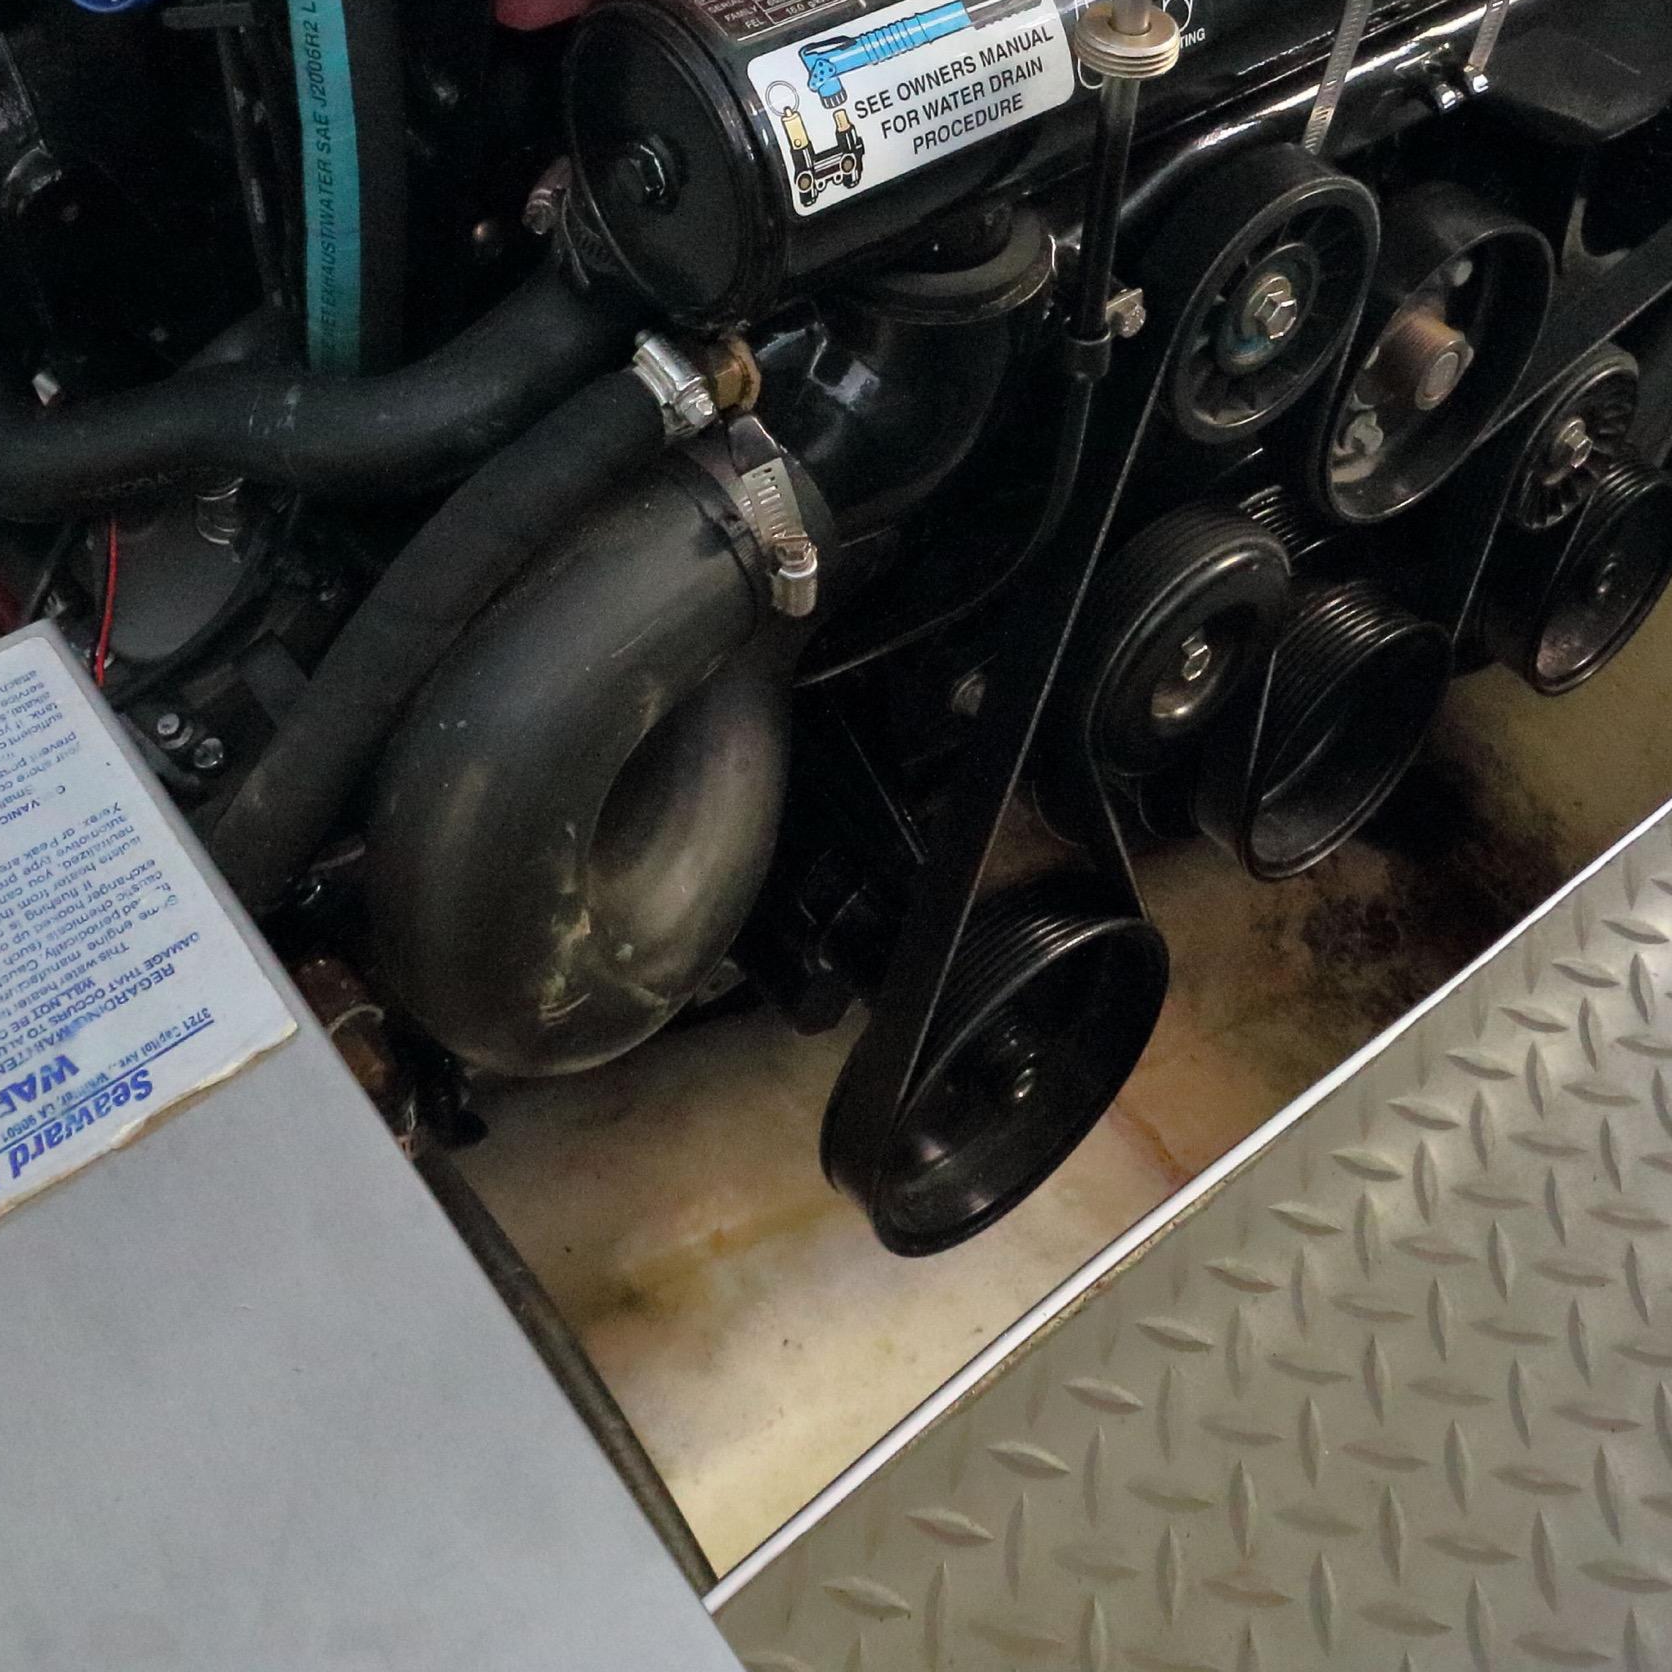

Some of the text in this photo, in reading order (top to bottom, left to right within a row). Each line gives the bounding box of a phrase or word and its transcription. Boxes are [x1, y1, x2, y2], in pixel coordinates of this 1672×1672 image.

[724, 4, 759, 22] FAMILY
[744, 18, 766, 29] FEL
[301, 18, 328, 116] J2006R2
[854, 26, 1054, 120] SEE OWNERS MANUAL
[880, 56, 1044, 140] FOR WATER DRAIN
[912, 92, 1024, 156] PROCEDURE
[312, 116, 332, 158] SAE
[23, 837, 59, 859] Peak
[27, 868, 53, 887] you
[53, 862, 96, 890] heater
[17, 888, 49, 909] from
[24, 887, 79, 920] flushing
[12, 929, 30, 944] up
[87, 919, 132, 950] engine
[97, 941, 129, 962] This
[144, 931, 199, 969] DAMAGE
[60, 958, 97, 984] water
[108, 967, 142, 992] THAT
[59, 977, 95, 1000] WILL
[31, 995, 61, 1020] NOT
[48, 988, 105, 1023] OCCURS
[10, 1015, 30, 1032] BE
[26, 1022, 47, 1038] TO
[182, 1007, 211, 1030] 3721
[9, 1070, 152, 1176] Seaward
